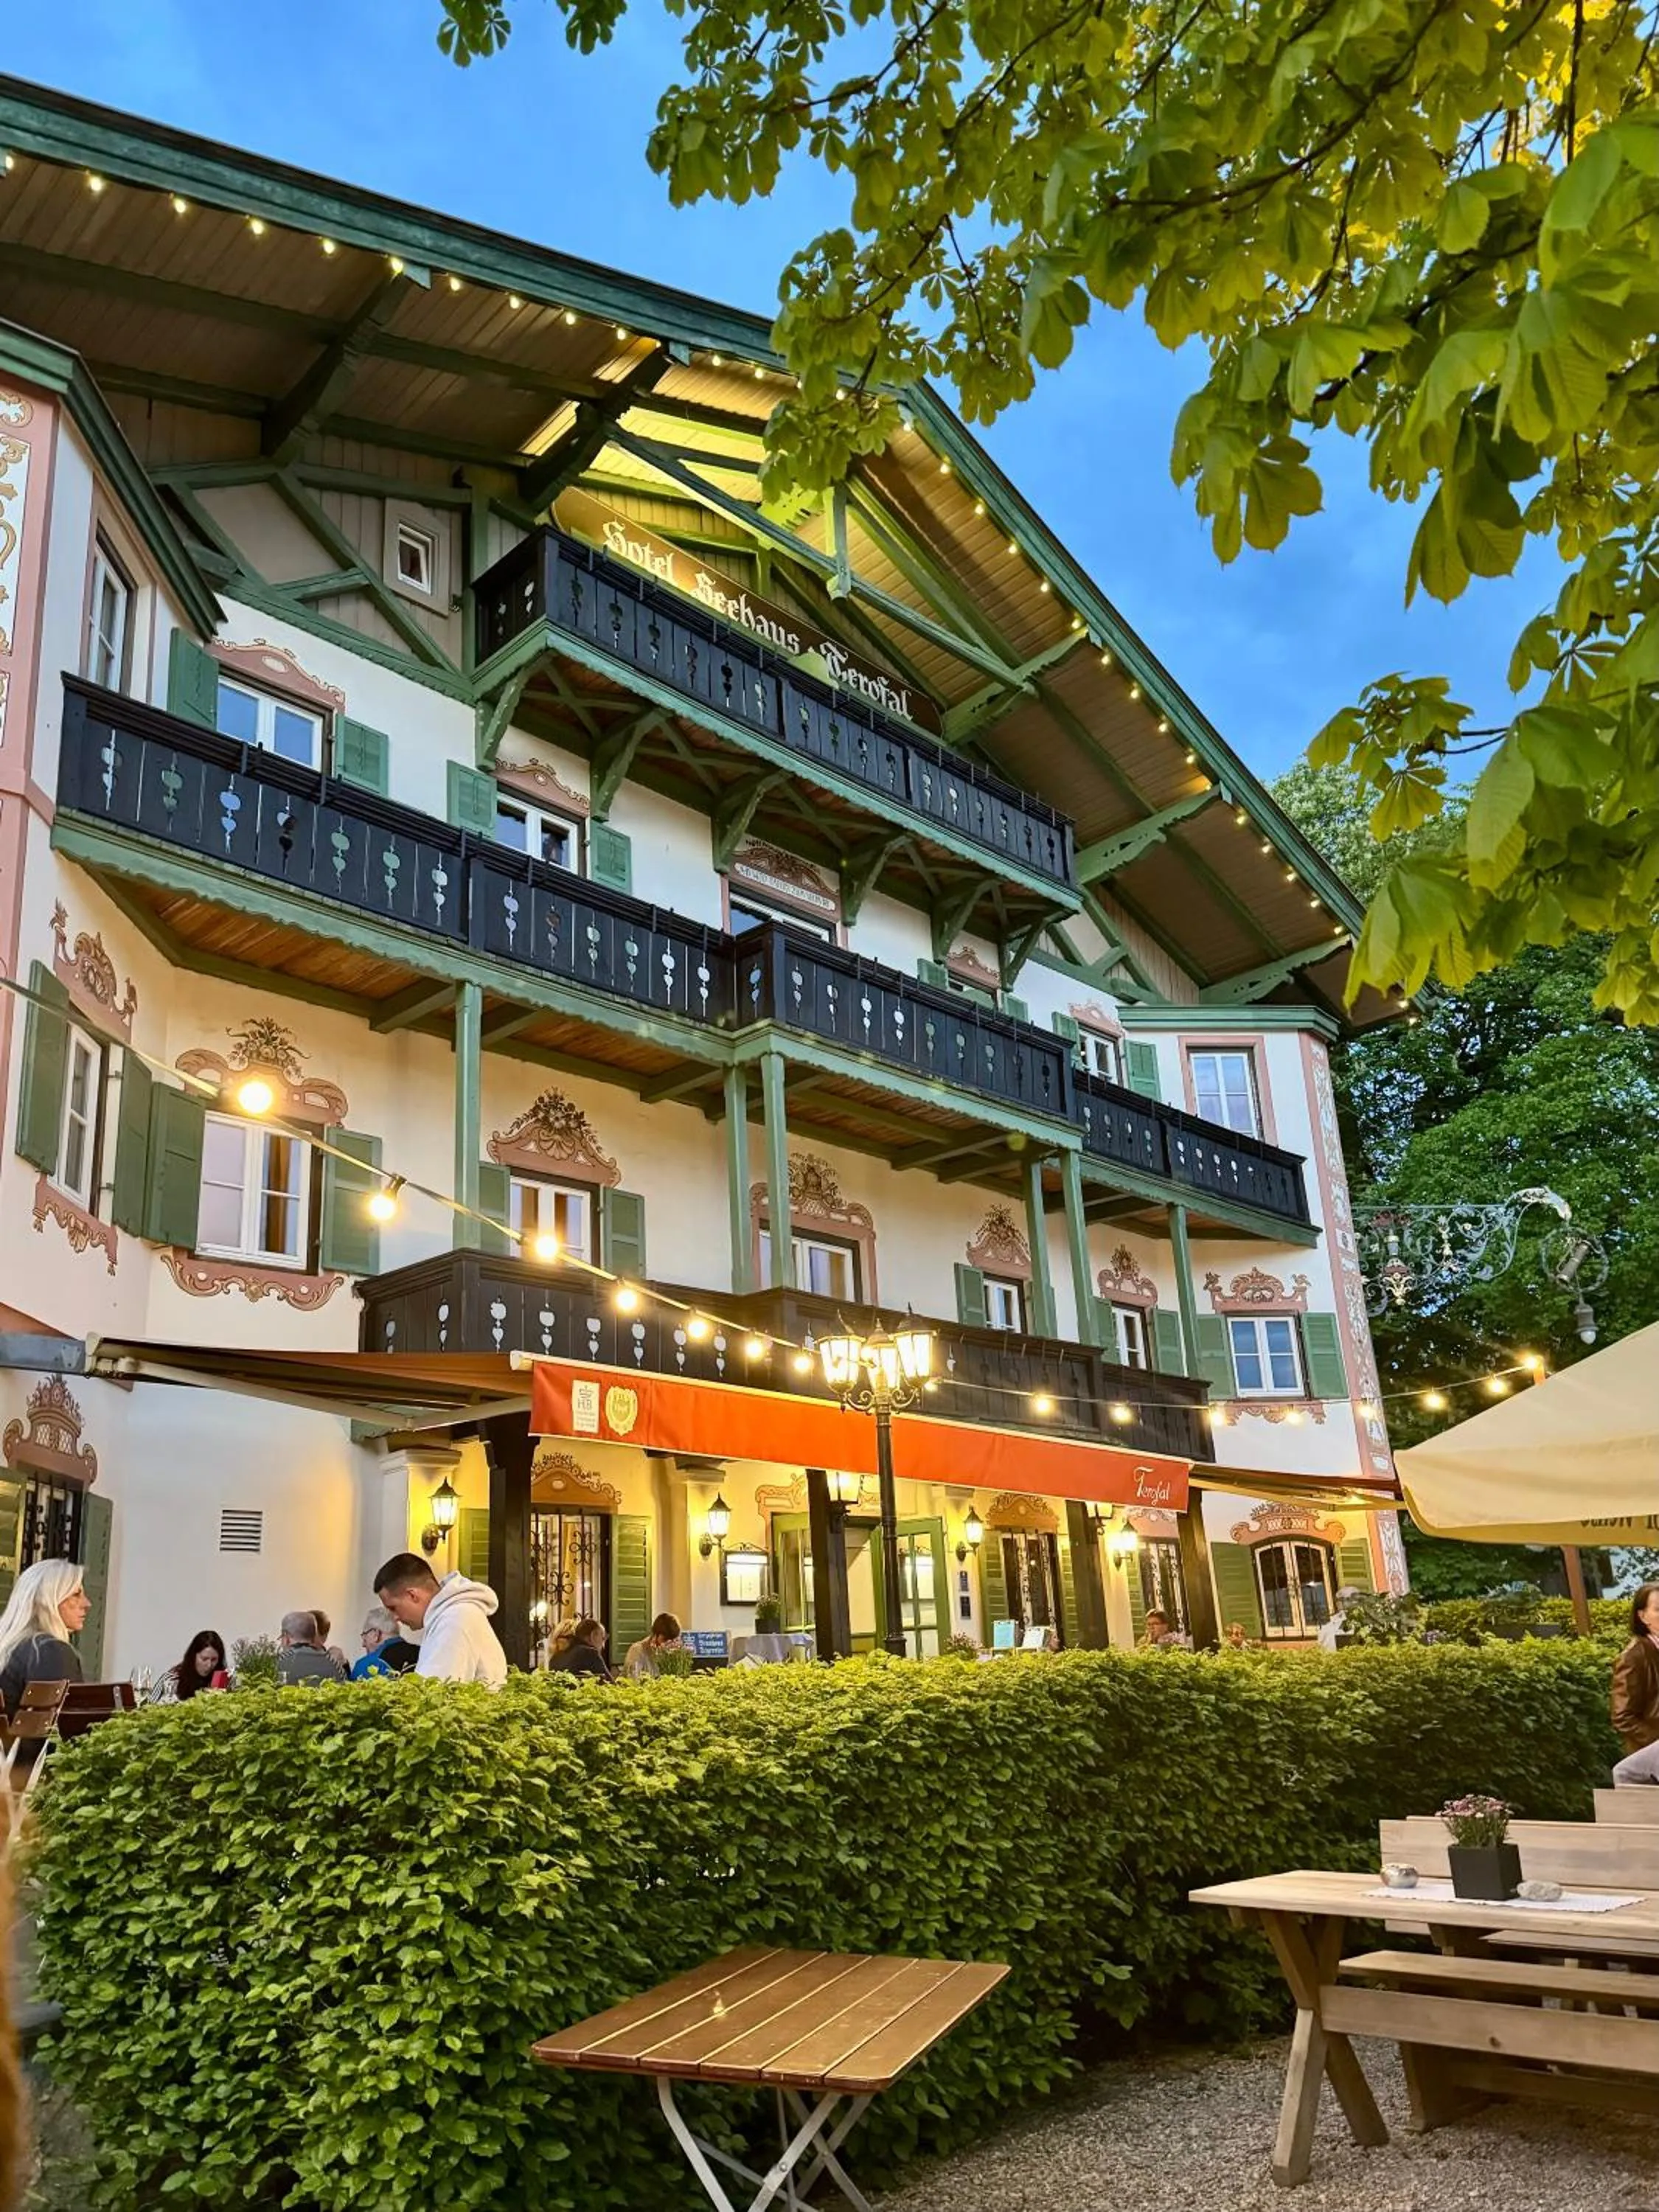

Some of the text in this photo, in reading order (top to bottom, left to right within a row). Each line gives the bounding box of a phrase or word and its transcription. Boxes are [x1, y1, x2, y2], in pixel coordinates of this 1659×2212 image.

[602, 521, 914, 721] Hotel Seehaus Terofal
